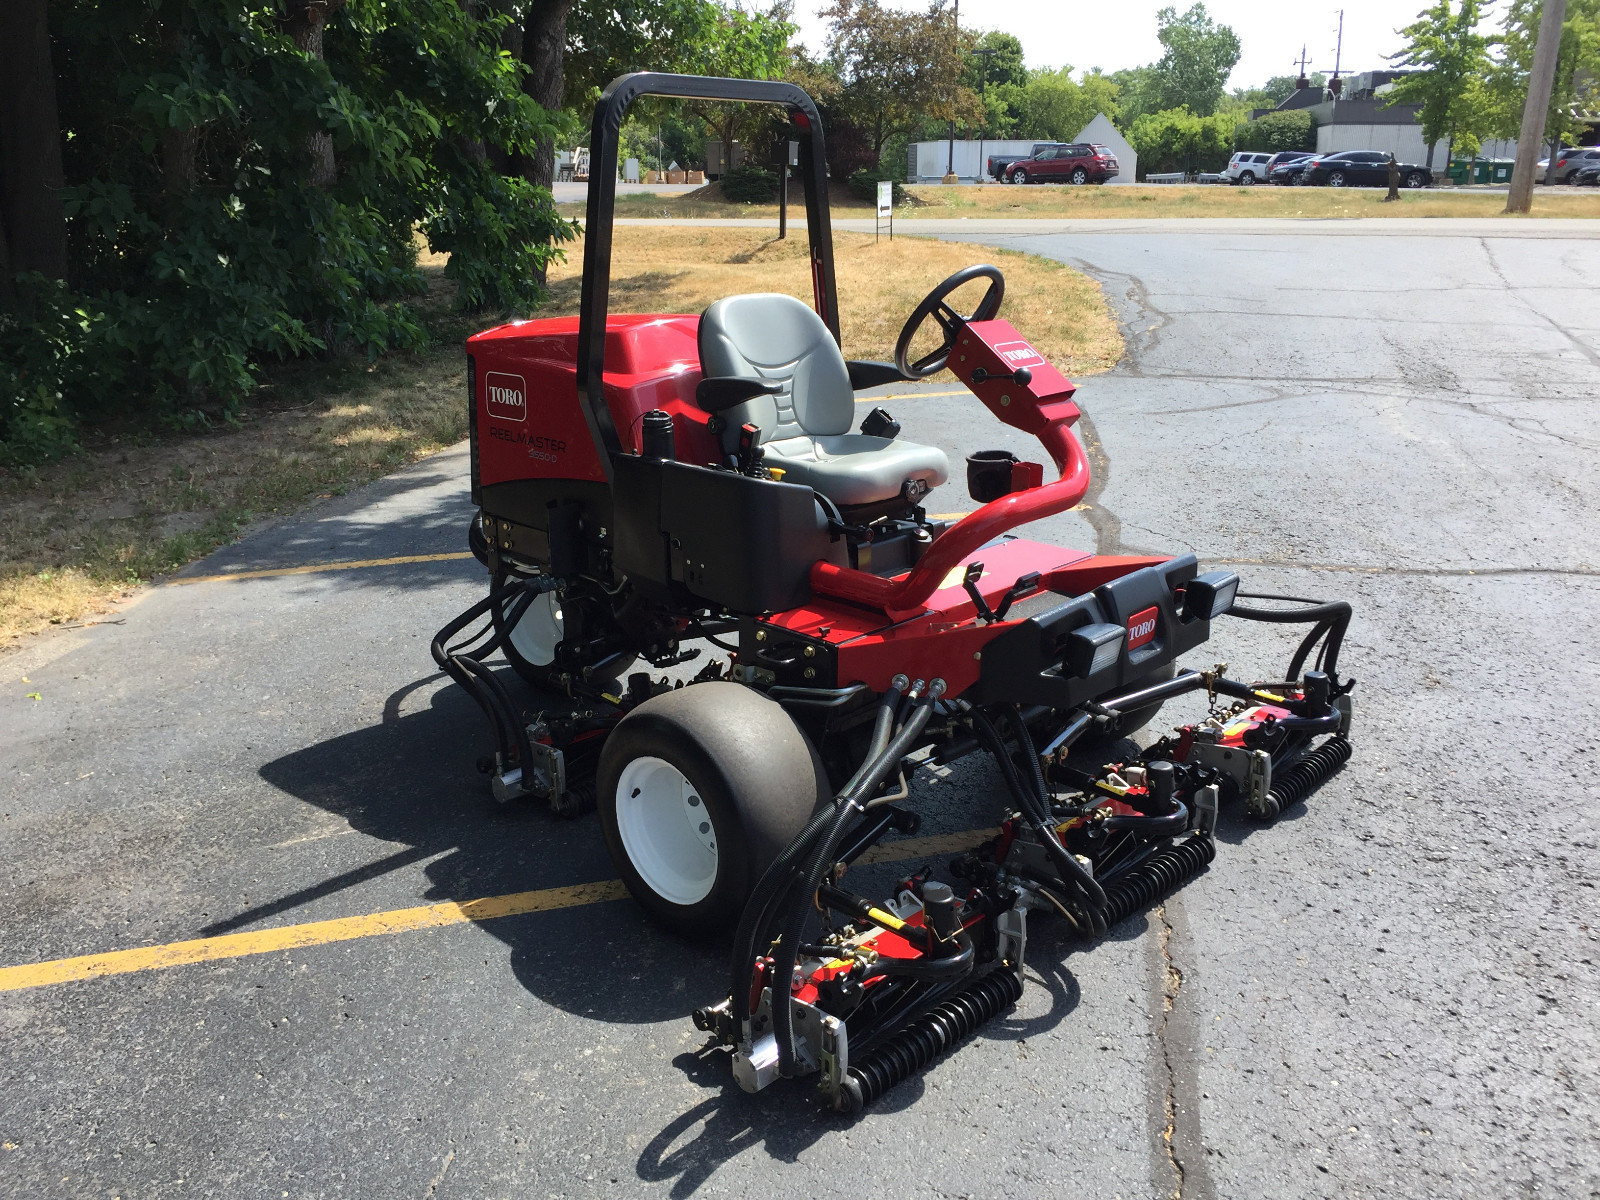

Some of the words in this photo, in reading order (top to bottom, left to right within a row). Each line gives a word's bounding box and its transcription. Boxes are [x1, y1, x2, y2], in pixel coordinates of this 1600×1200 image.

[1002, 348, 1037, 361] TORO
[489, 386, 523, 406] TORO
[489, 426, 567, 453] REELMASTER
[1129, 618, 1156, 641] TORO
